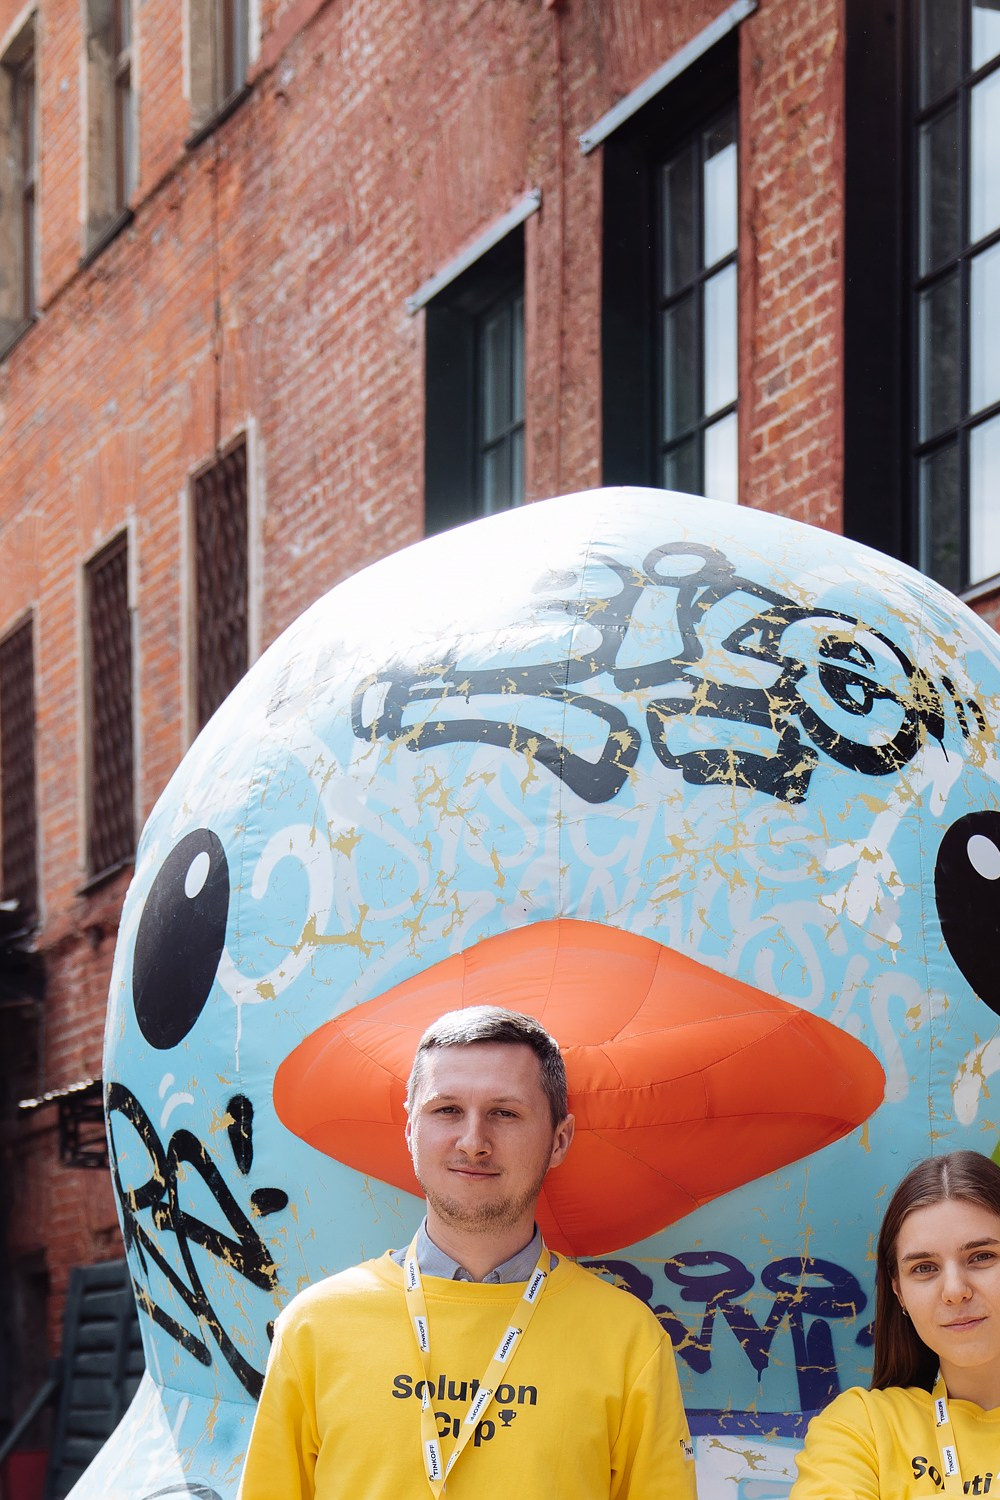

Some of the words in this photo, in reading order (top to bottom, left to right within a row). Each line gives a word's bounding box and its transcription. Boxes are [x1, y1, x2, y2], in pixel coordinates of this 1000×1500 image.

[528, 1273, 543, 1300] TINKOFF
[500, 1330, 516, 1360] TINKOFF
[392, 1374, 538, 1406] Soluton
[429, 1444, 439, 1476] TINKOFF
[946, 1449, 955, 1473] TINKOFF
